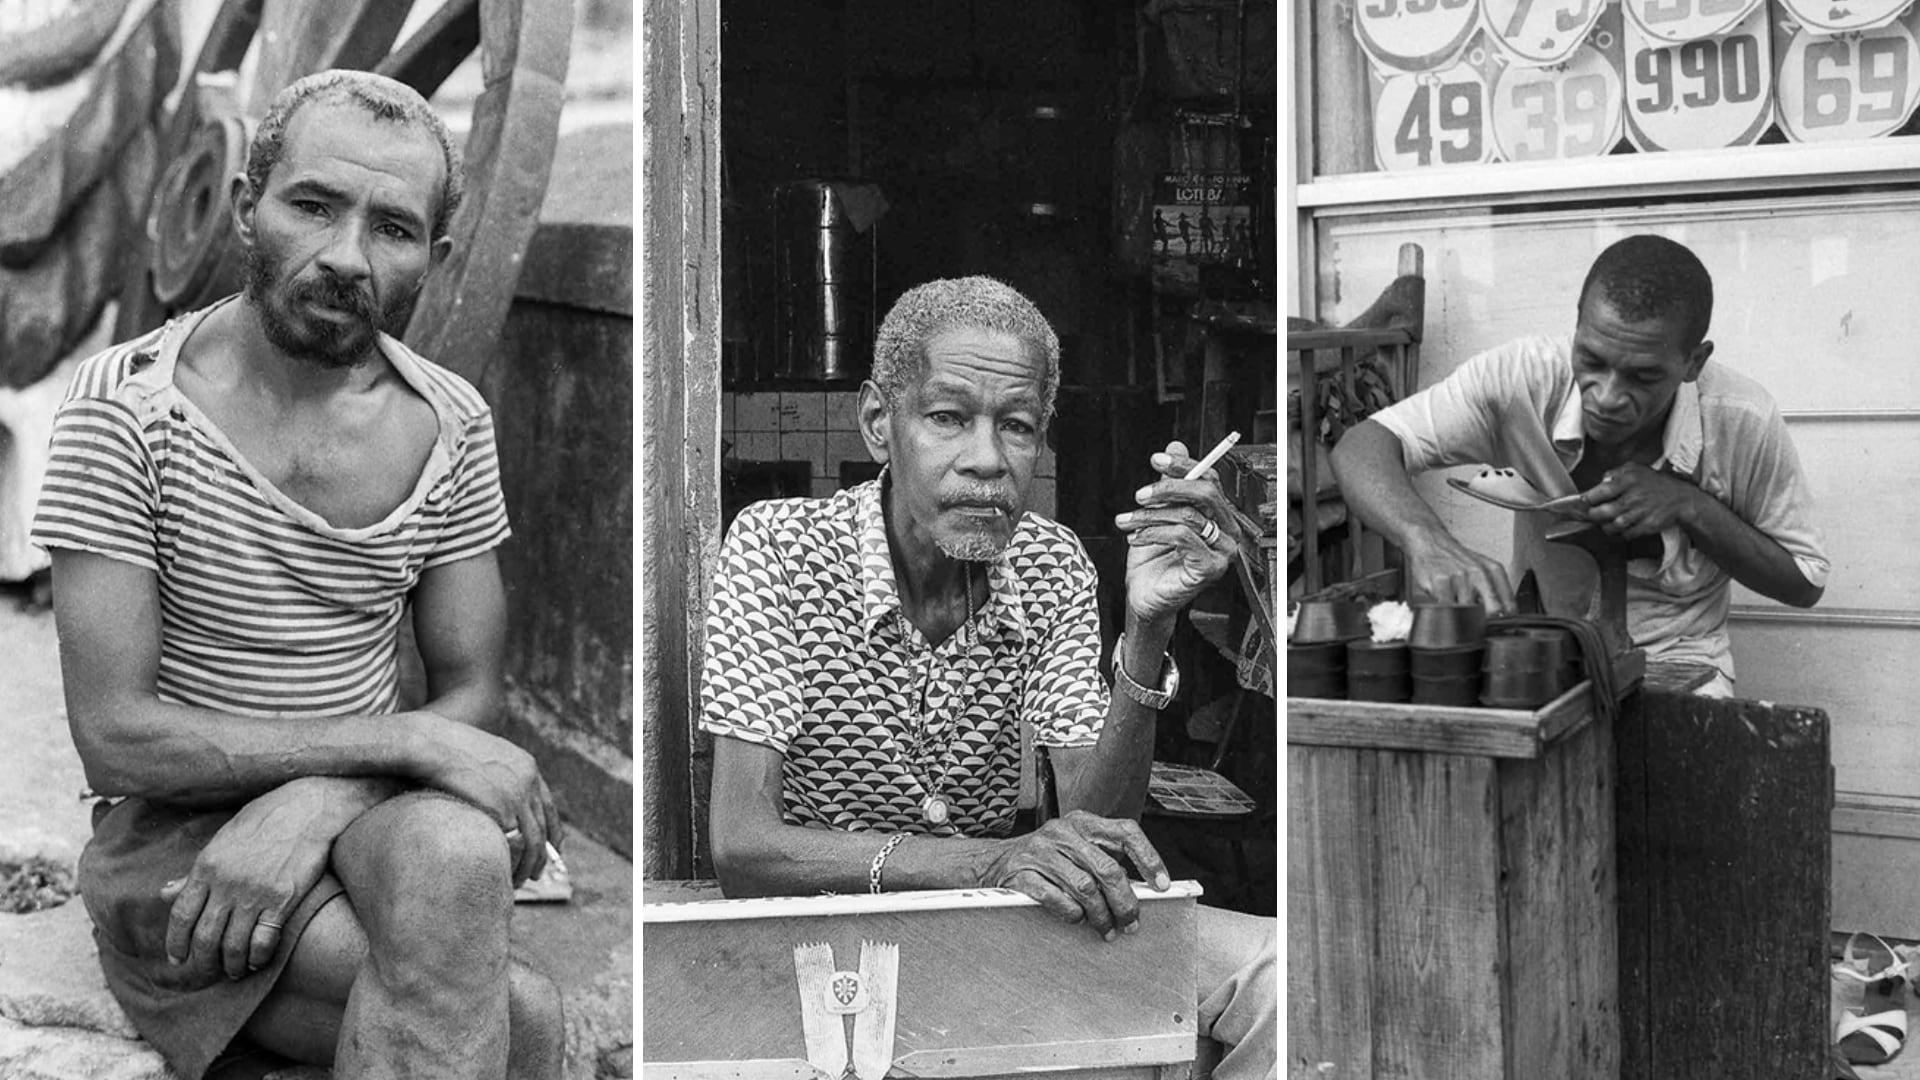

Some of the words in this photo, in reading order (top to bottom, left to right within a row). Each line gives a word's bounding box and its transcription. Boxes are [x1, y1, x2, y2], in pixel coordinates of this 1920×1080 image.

[1511, 73, 1607, 161] 39
[1634, 34, 1760, 114] 9,90
[1803, 36, 1909, 129] 69
[1395, 81, 1483, 166] 49
